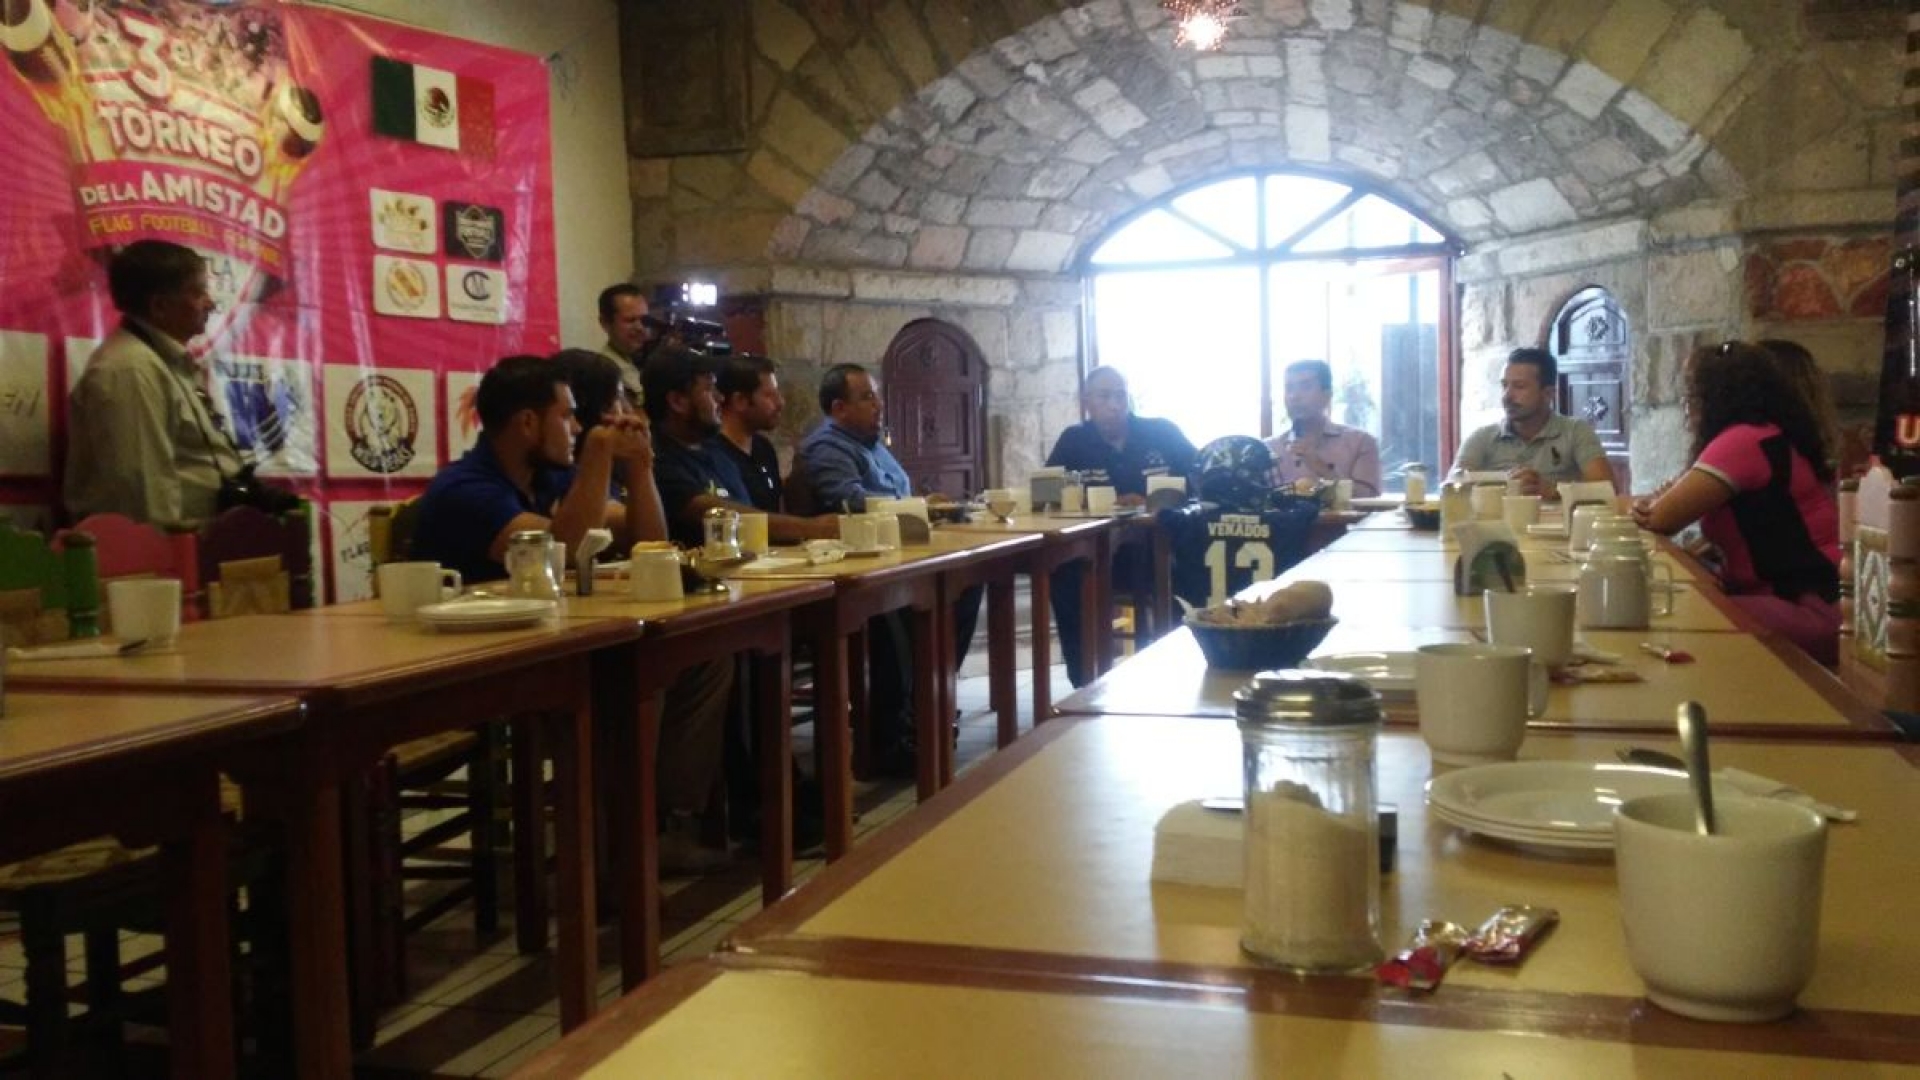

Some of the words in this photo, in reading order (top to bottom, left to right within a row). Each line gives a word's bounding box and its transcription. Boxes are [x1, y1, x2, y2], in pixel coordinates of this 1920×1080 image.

[98, 104, 262, 177] TORNEO
[80, 184, 108, 204] DE
[111, 181, 138, 201] LA
[141, 170, 285, 238] AMISTAD
[89, 214, 133, 236] FLAG
[141, 213, 214, 241] FOOTBALL
[1208, 521, 1270, 539] VENADOS
